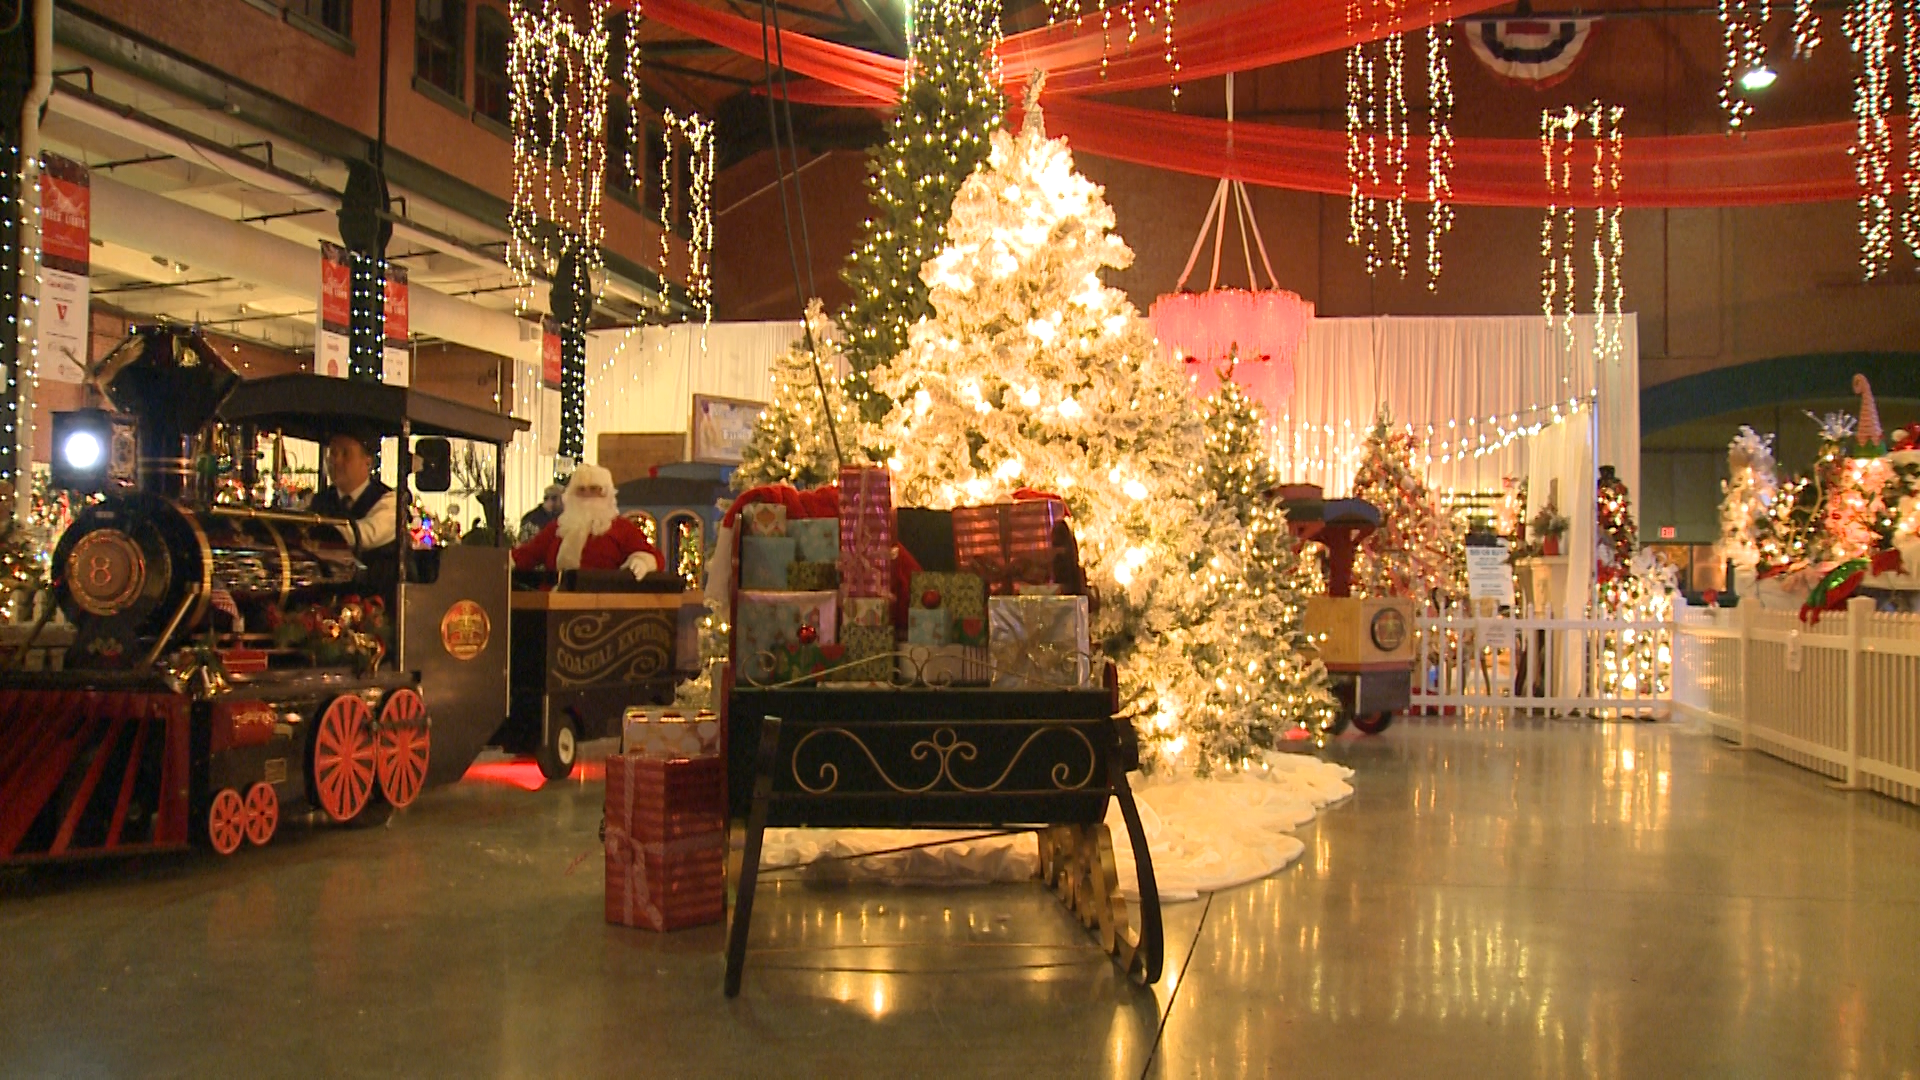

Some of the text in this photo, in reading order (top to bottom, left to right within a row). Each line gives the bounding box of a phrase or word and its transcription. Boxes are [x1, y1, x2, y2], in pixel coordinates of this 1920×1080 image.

[90, 556, 112, 586] 8
[557, 622, 671, 675] COASTAL EXPRESS
